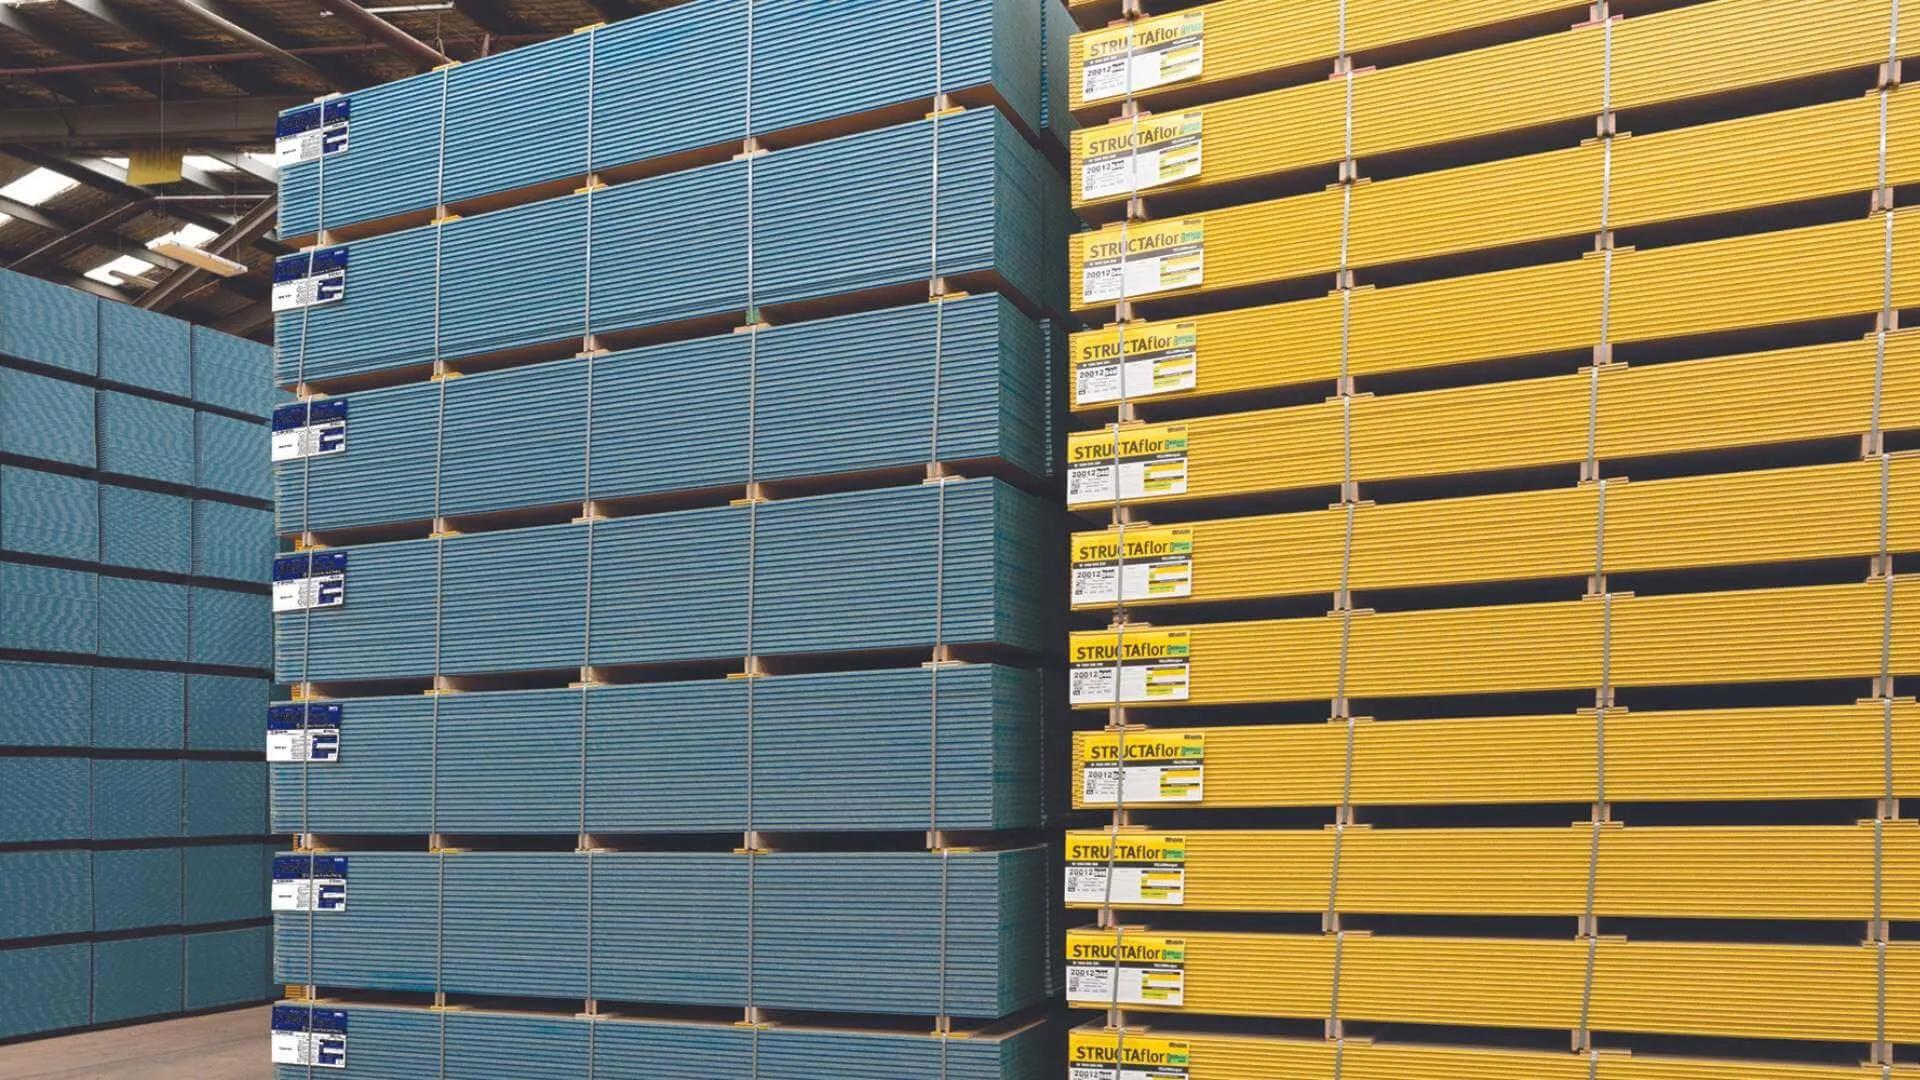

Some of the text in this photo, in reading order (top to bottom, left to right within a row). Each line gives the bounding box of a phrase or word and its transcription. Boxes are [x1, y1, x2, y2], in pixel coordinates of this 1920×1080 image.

[1090, 27, 1179, 57] STRUTAflor
[1089, 126, 1178, 155] STRUCTAflor
[1083, 336, 1172, 360] STRUCTAflor
[1075, 439, 1163, 460] STRUCTAflor
[1079, 540, 1168, 560] STRUCTAflor
[1077, 643, 1166, 660] STRUCTAflor
[1073, 944, 1161, 960] STRUCTAflor
[1076, 1046, 1165, 1063] STRUCTAflor
